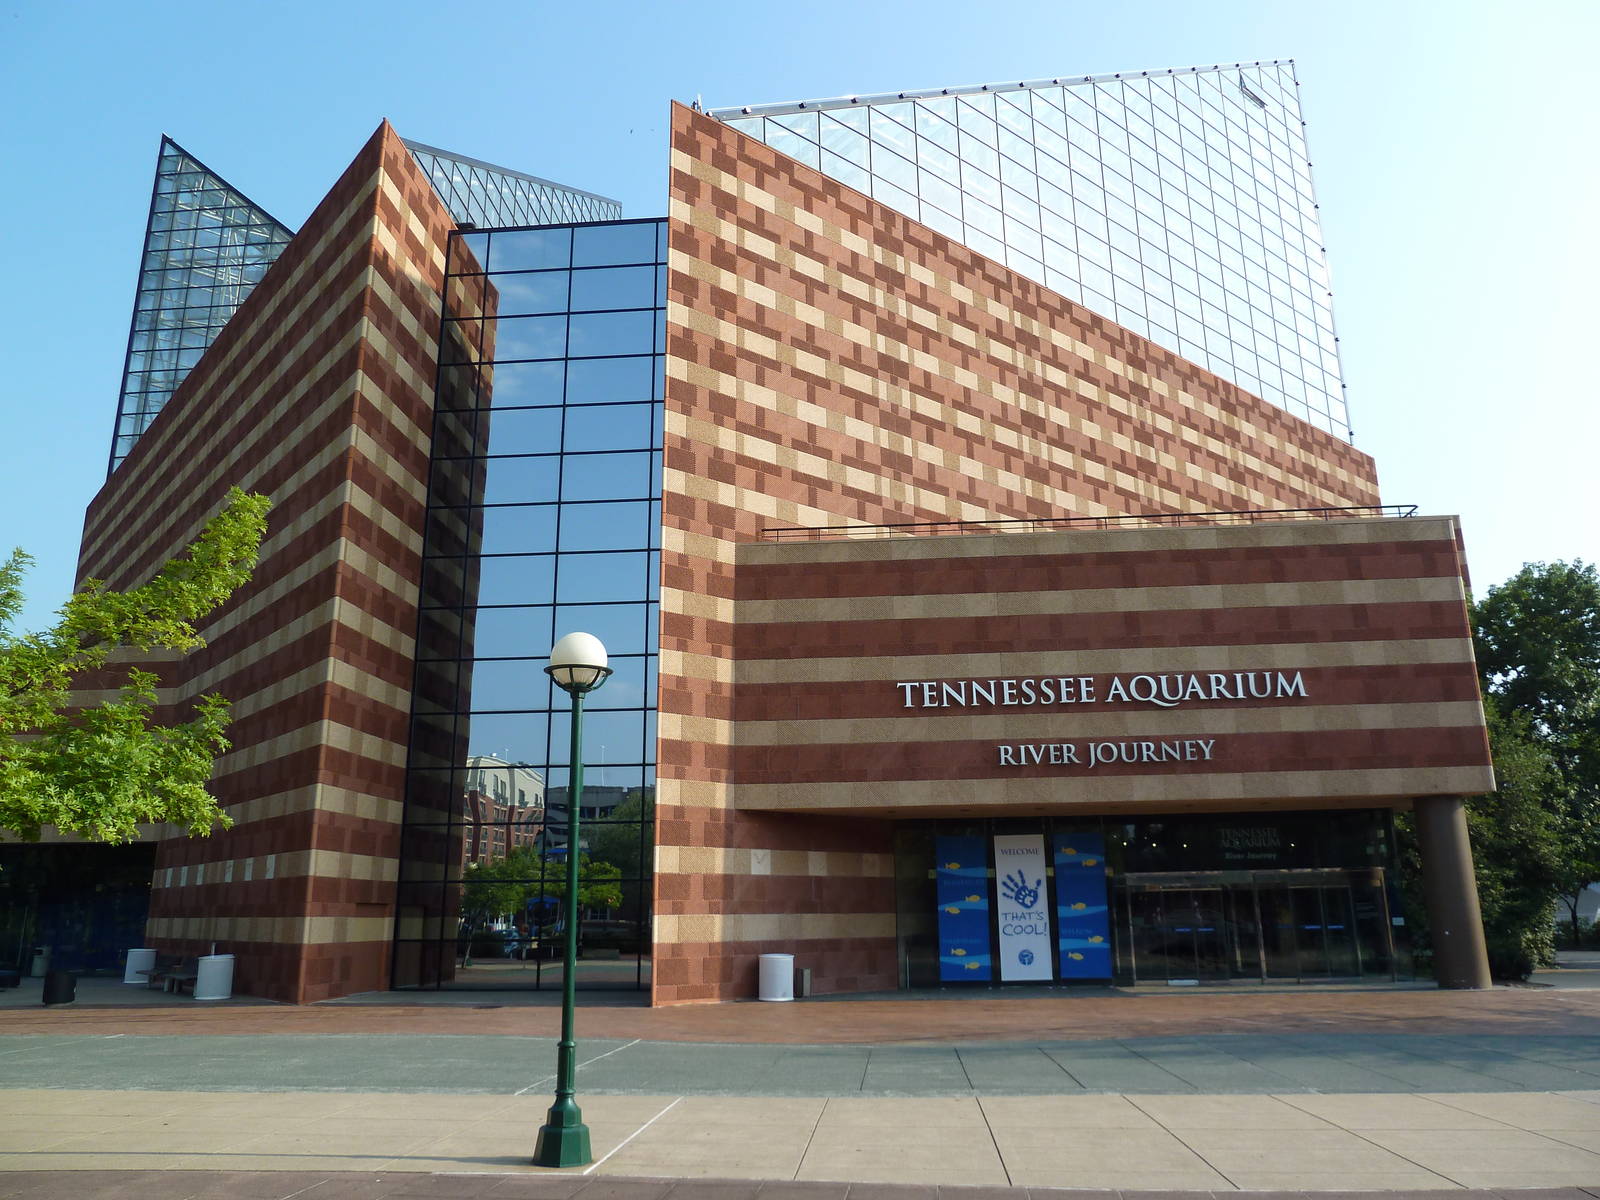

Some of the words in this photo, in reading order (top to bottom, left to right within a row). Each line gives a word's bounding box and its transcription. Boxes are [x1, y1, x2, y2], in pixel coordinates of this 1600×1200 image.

[896, 676, 1096, 708] TENNESSEE
[1105, 671, 1309, 707] AQUARIUM
[998, 743, 1081, 766] RIVER
[1088, 739, 1216, 769] JOURNEY
[1001, 848, 1040, 856] WELCOME
[1002, 911, 1044, 921] THAT'S
[1002, 922, 1047, 937] COOL!
